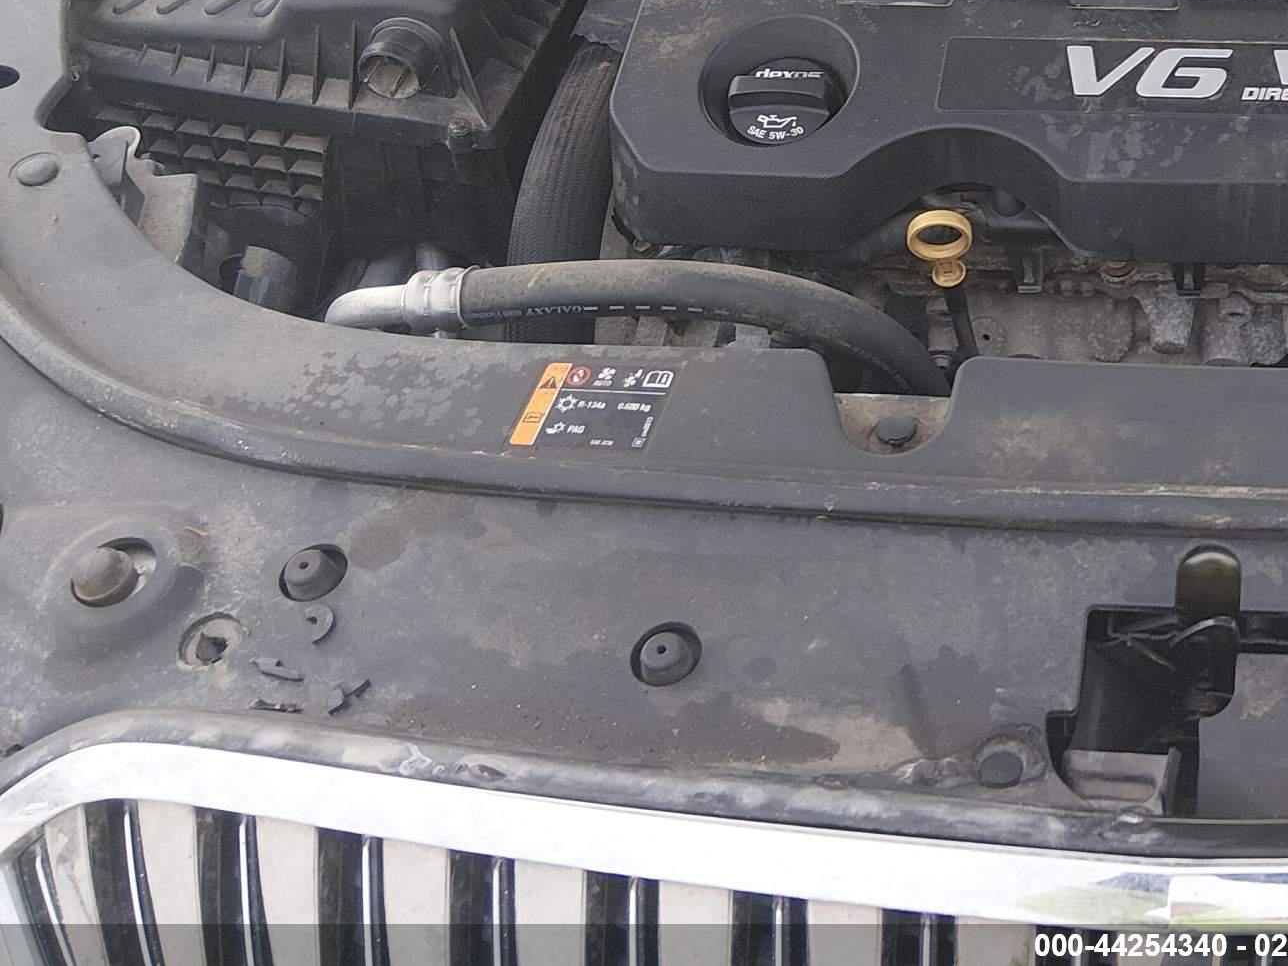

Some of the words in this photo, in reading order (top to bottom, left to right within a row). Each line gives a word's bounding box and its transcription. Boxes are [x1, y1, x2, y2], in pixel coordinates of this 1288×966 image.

[1066, 45, 1233, 99] V6
[747, 125, 767, 139] SAE
[768, 126, 804, 140] 5W-30
